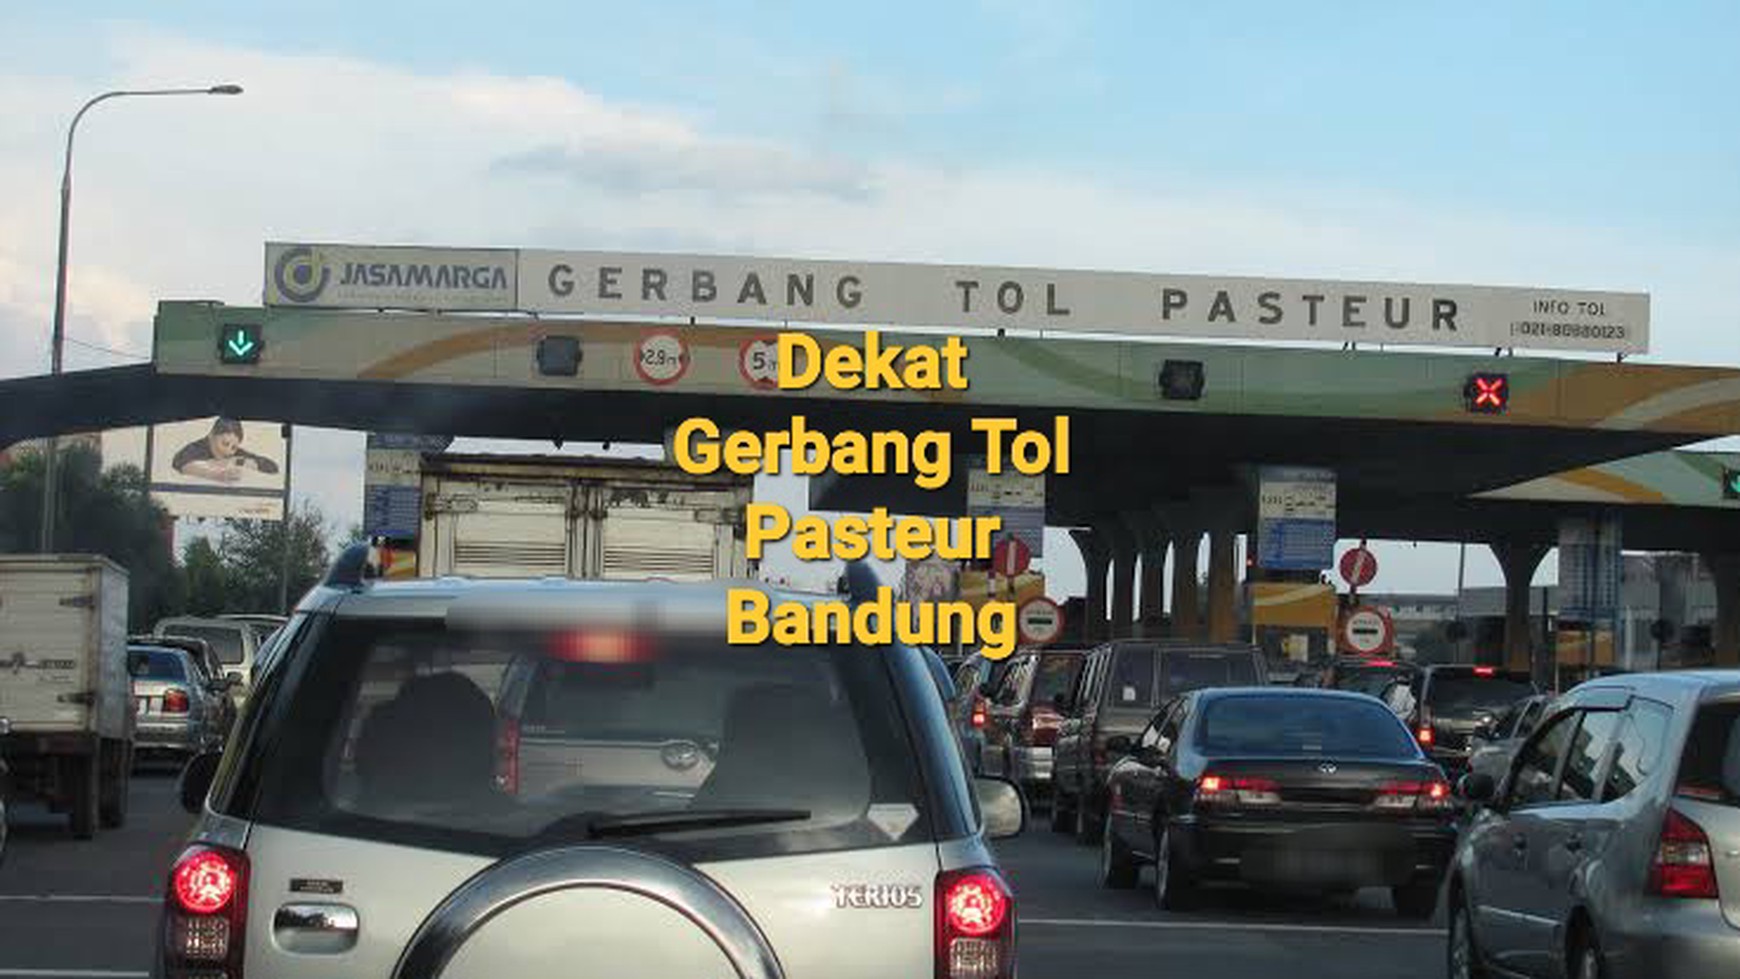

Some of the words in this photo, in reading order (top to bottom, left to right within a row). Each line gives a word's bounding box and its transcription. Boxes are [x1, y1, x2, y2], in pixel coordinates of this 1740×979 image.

[340, 263, 507, 290] JASAMARGA
[548, 264, 862, 308] GERBANG
[955, 280, 1070, 315] TOL
[1162, 288, 1458, 332] PASTEUR
[1533, 301, 1570, 315] INFO
[1576, 301, 1605, 316] TOL
[832, 884, 923, 908] TERIOS
